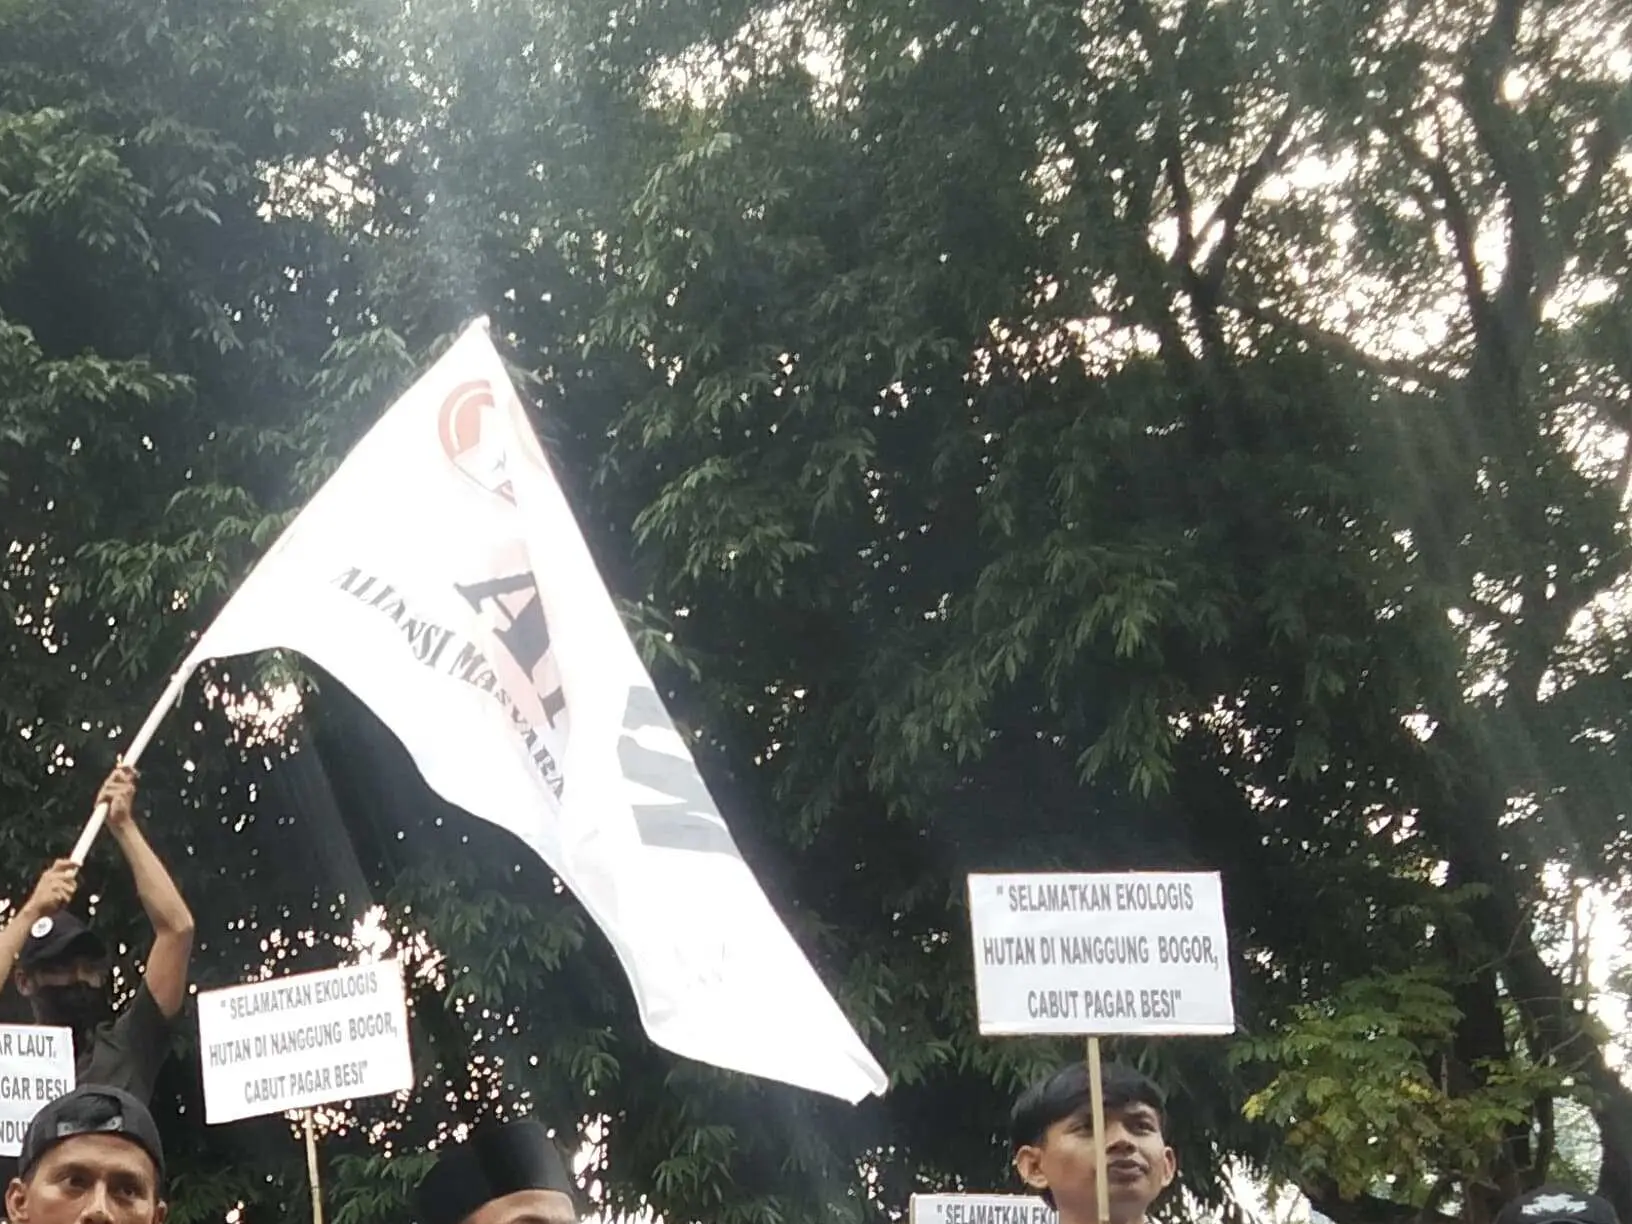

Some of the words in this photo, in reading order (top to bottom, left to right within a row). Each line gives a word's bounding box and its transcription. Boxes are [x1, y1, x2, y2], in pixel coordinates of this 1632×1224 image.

[330, 566, 456, 669] ALIANSI
[1009, 883, 1110, 912] SELAMATKAN
[1117, 882, 1194, 911] EKOLOGIS
[983, 937, 1036, 965] HUTAN
[1041, 937, 1055, 965] DI
[1061, 936, 1149, 965] NANGGUNG
[1158, 936, 1218, 971] BOGOR,
[230, 985, 312, 1019] SELAMATKAN
[316, 971, 378, 1004] EKOLOGIS
[1028, 990, 1078, 1019] CABUT
[1084, 990, 1136, 1018] PAGAR
[209, 1039, 251, 1066] HUTAN
[255, 1034, 267, 1058] DI
[271, 1022, 342, 1057] NANGGUNG
[349, 1012, 397, 1041] BOGOR,
[36, 1078, 67, 1101] BESI
[245, 1075, 286, 1104] CABUT
[290, 1068, 331, 1096] PAGAR
